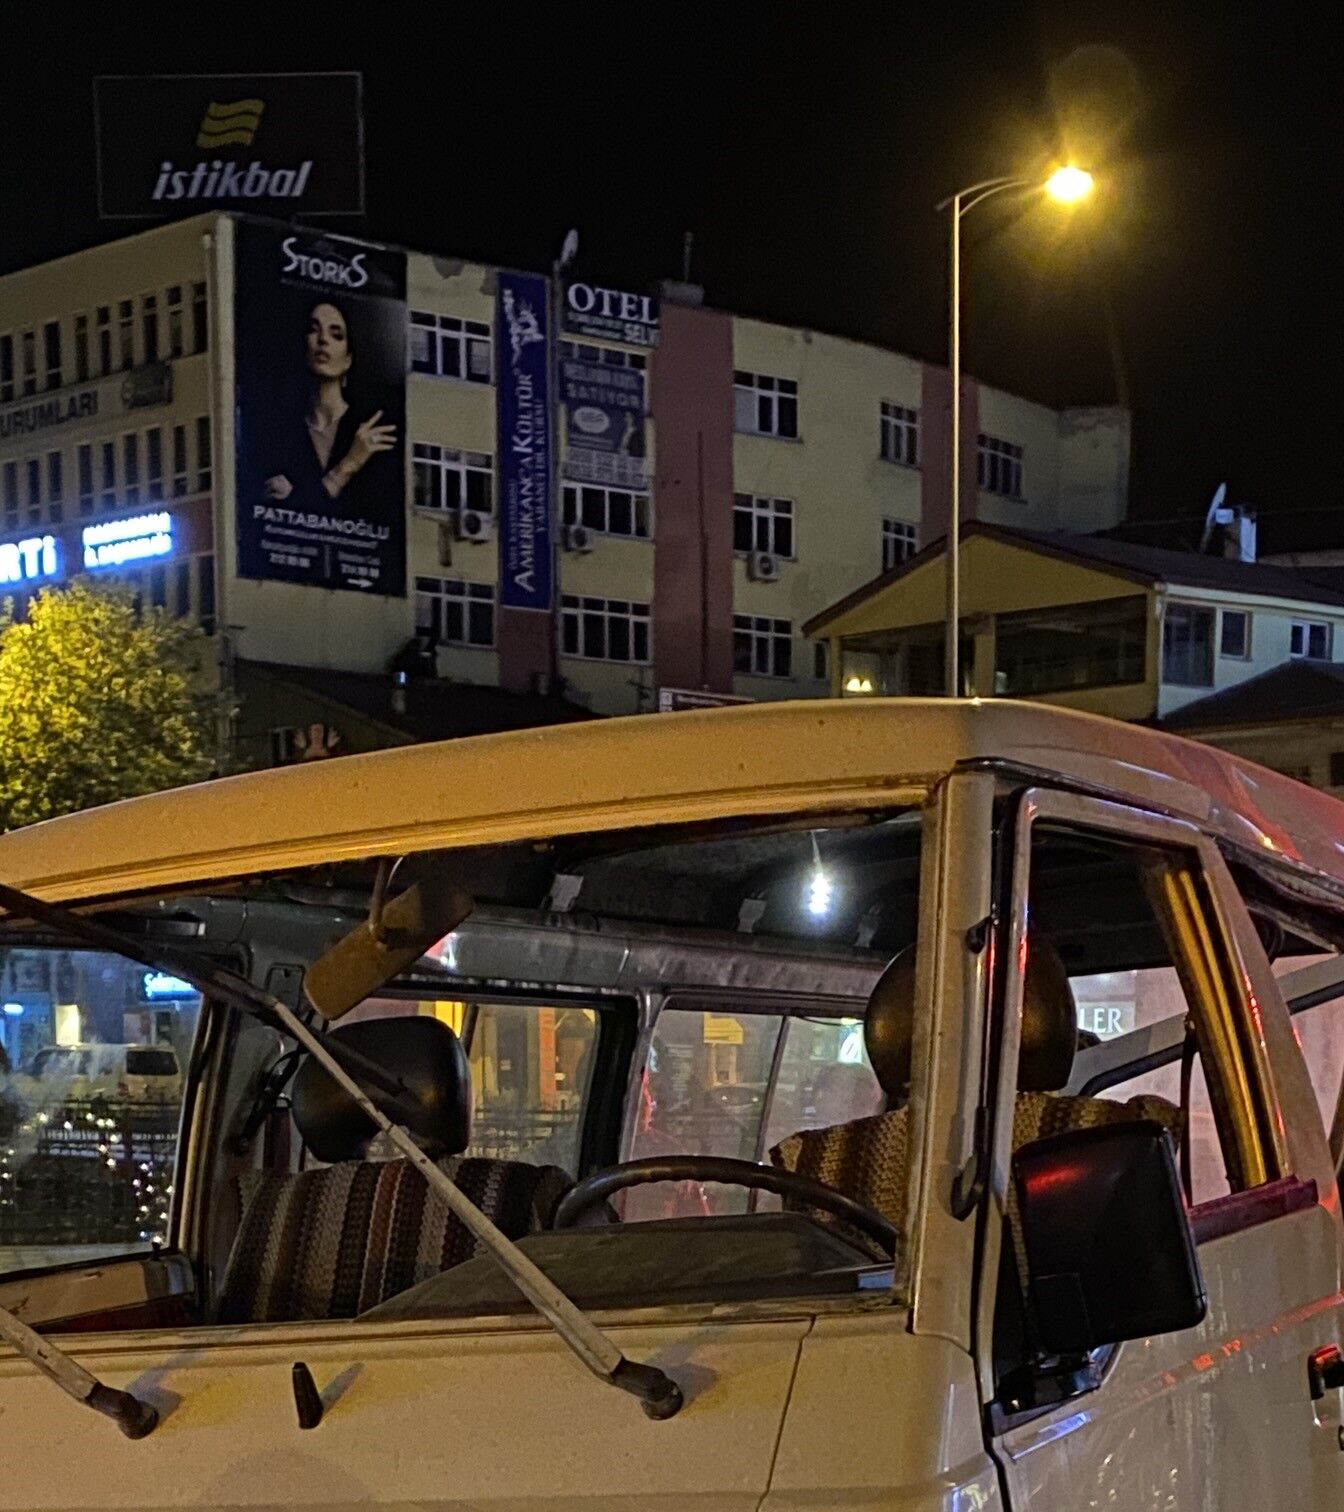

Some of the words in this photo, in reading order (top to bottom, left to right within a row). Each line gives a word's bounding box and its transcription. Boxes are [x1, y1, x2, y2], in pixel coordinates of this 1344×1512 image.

[152, 159, 313, 200] istikbal
[282, 236, 369, 288] STORKS
[567, 283, 659, 324] OTEL
